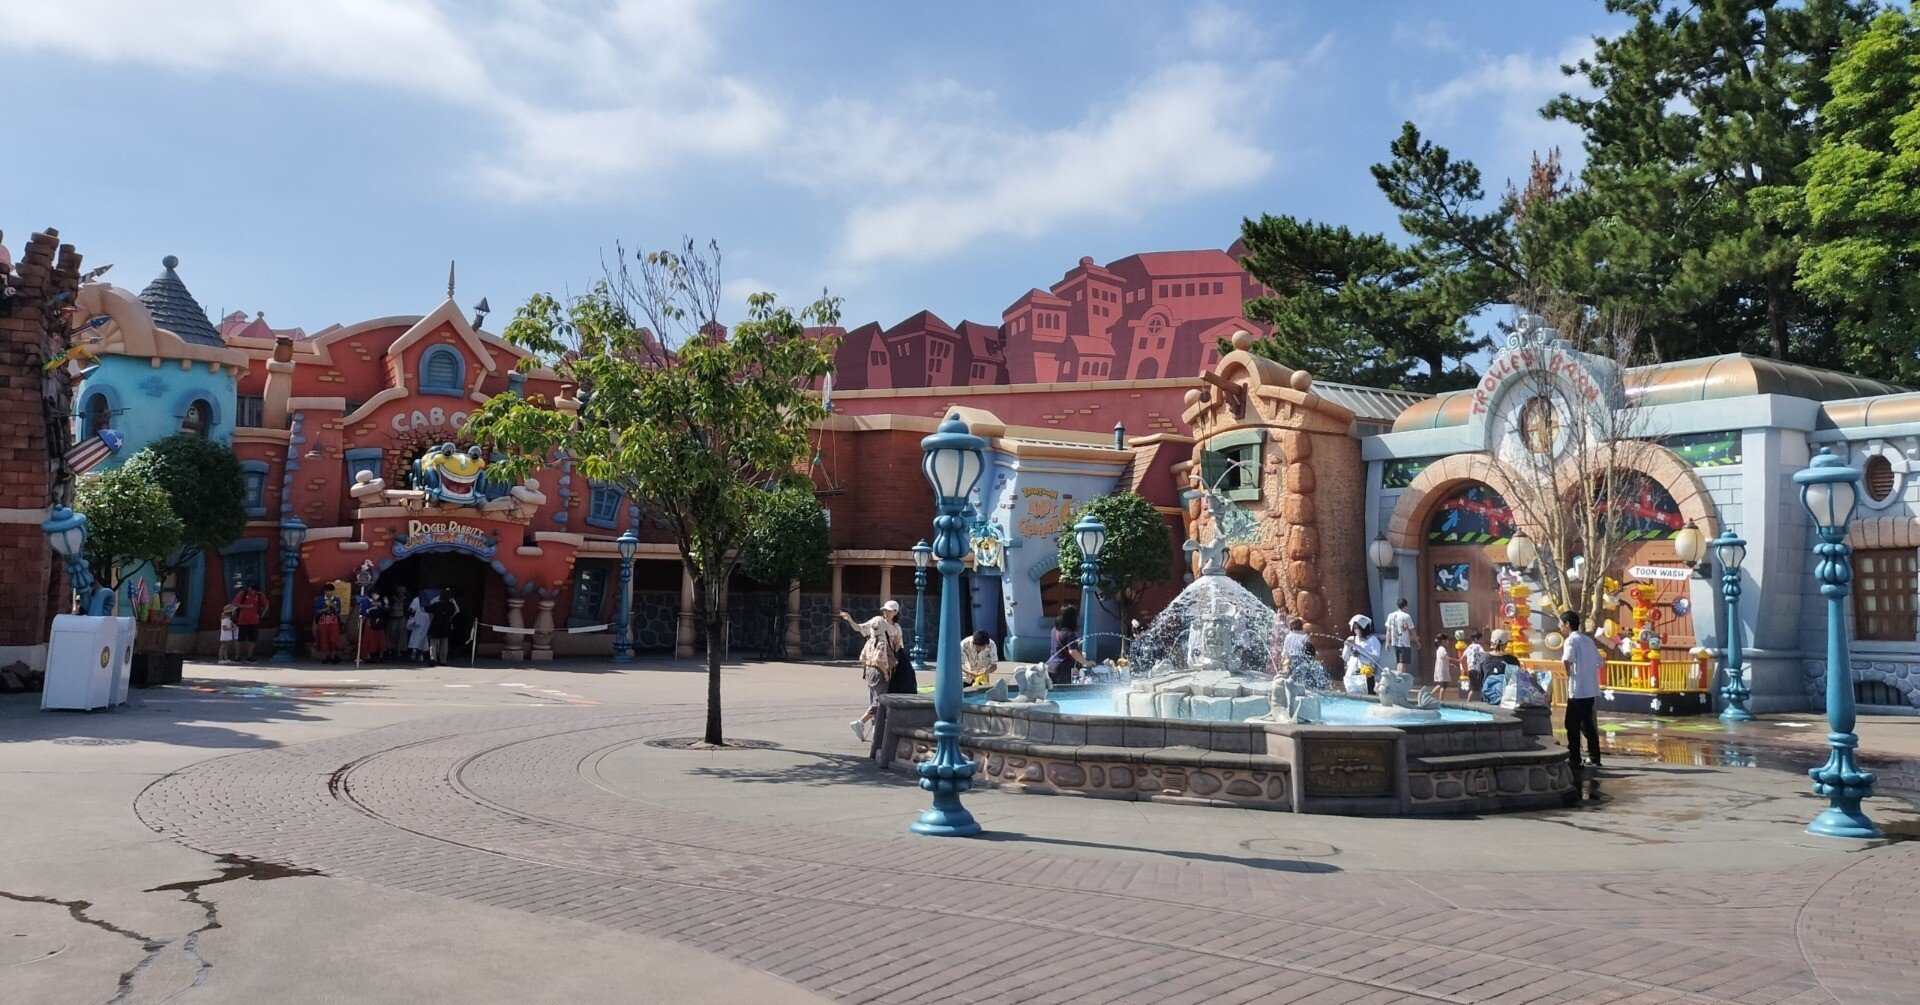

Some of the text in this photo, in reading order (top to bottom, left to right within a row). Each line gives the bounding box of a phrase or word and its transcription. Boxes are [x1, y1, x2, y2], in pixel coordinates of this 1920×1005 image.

[1473, 347, 1534, 415] TROLLEY
[391, 406, 469, 433] CAB C
[408, 519, 447, 538] ROGER
[1635, 567, 1684, 578] TOON WASH
